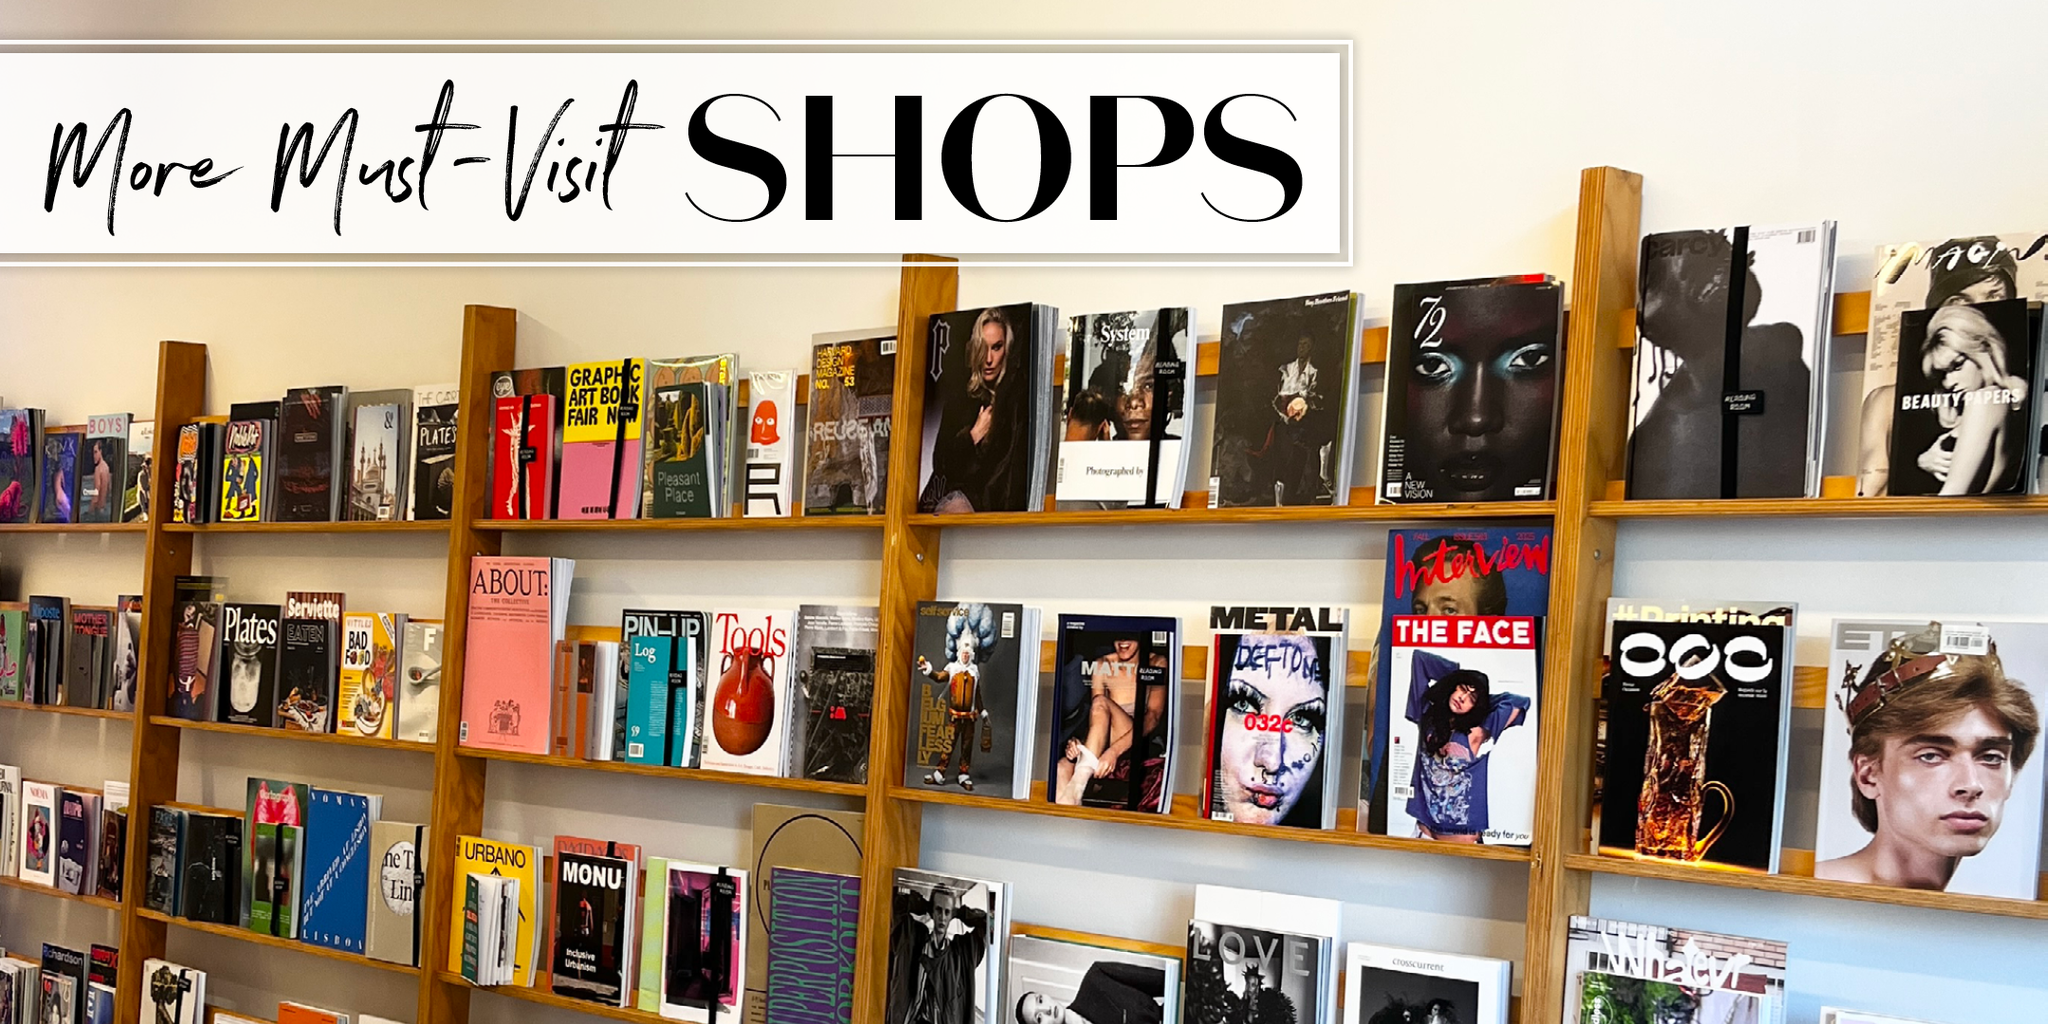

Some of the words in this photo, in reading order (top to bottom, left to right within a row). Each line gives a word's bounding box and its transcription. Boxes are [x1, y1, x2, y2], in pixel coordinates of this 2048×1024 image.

[1413, 295, 1447, 349] 72
[1101, 325, 1150, 347] System
[816, 356, 845, 369] DESIGN
[816, 365, 855, 378] MAGAZINE
[570, 364, 641, 387] GRAPHC
[844, 377, 855, 387] 53
[569, 387, 598, 407] ART
[600, 384, 640, 405] BOK
[1901, 391, 1960, 411] BEAUTY
[1963, 388, 2021, 407] PAPERS
[88, 417, 127, 434] BOYS!
[568, 407, 599, 427] FAIR
[420, 426, 457, 446] PLATES
[658, 471, 701, 487] Pleasant
[1086, 466, 1134, 478] Photographed
[1405, 472, 1412, 480] A
[665, 487, 695, 503] Place
[1405, 481, 1426, 490] NEW
[1405, 489, 1434, 499] VISION
[1395, 533, 1549, 599] Interview
[472, 568, 548, 596] ABOUT:
[288, 597, 340, 619] Serviette
[74, 613, 107, 625] MOTHER
[224, 607, 278, 644] Plates
[1210, 606, 1344, 631] METAL
[74, 625, 108, 638] TONGUE
[287, 624, 324, 643] EATEN
[348, 631, 368, 649] BAD
[423, 628, 436, 651] F
[716, 613, 787, 658] Tools
[1396, 620, 1448, 643] THE
[1457, 620, 1530, 644] FACE
[634, 643, 656, 664] Log
[919, 724, 955, 740] FEAR
[1244, 713, 1293, 733] 032c
[918, 738, 952, 754] LESS
[1502, 829, 1514, 838] for
[465, 841, 526, 868] URBANO
[563, 861, 622, 890] MONU
[566, 948, 596, 961] Inclusive
[1192, 926, 1311, 976] LOVE
[565, 958, 596, 973] Urbanism
[1392, 957, 1446, 973] crosscurrent
